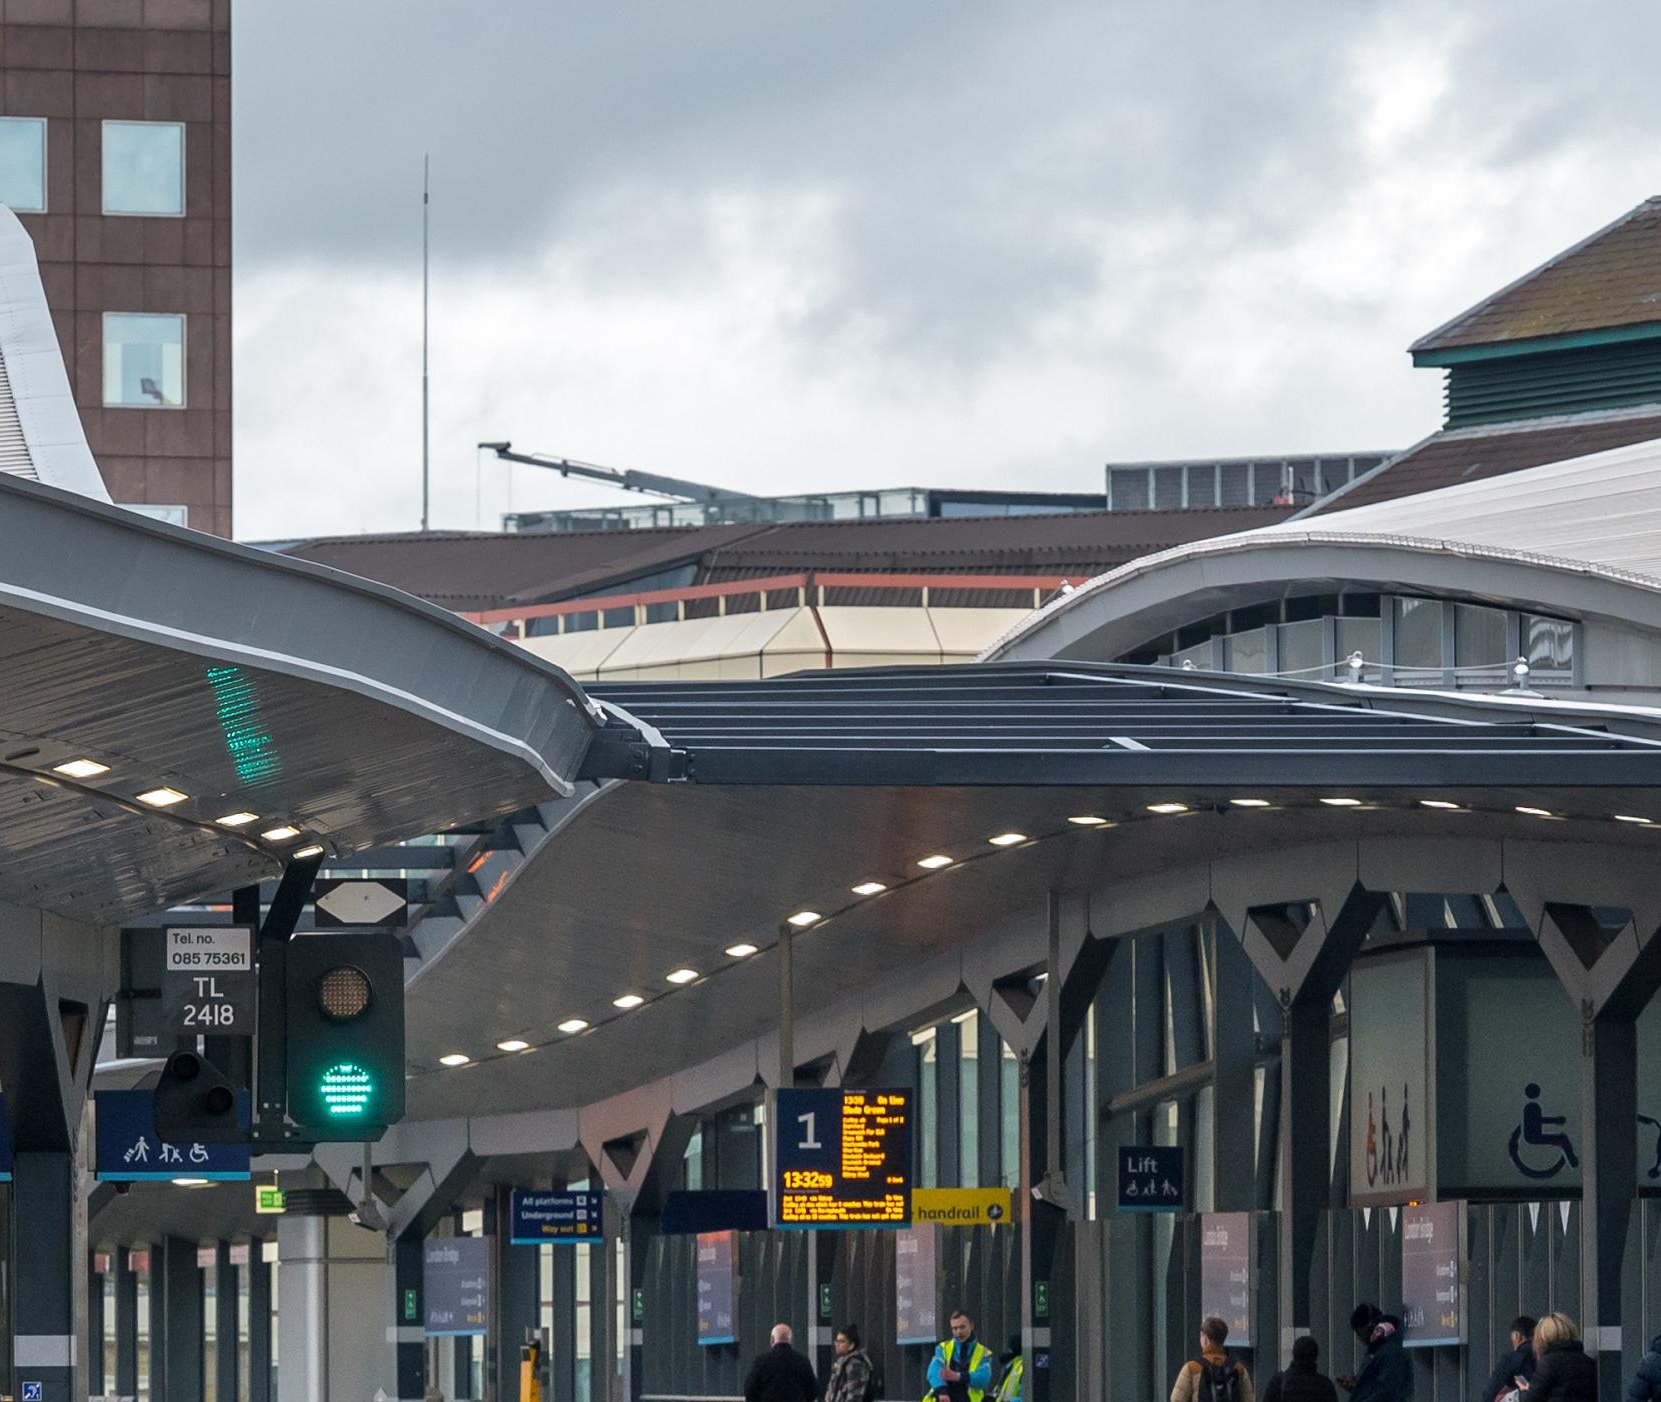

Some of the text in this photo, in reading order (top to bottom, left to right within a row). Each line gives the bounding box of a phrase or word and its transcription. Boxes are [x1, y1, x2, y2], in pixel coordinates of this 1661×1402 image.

[172, 933, 215, 944] Tel. no.
[172, 953, 245, 965] 085 75361
[193, 977, 224, 997] TL
[183, 1004, 234, 1026] 2418
[798, 1112, 822, 1149] 1
[1128, 1156, 1158, 1173] Lift
[918, 1206, 979, 1219] handrail
